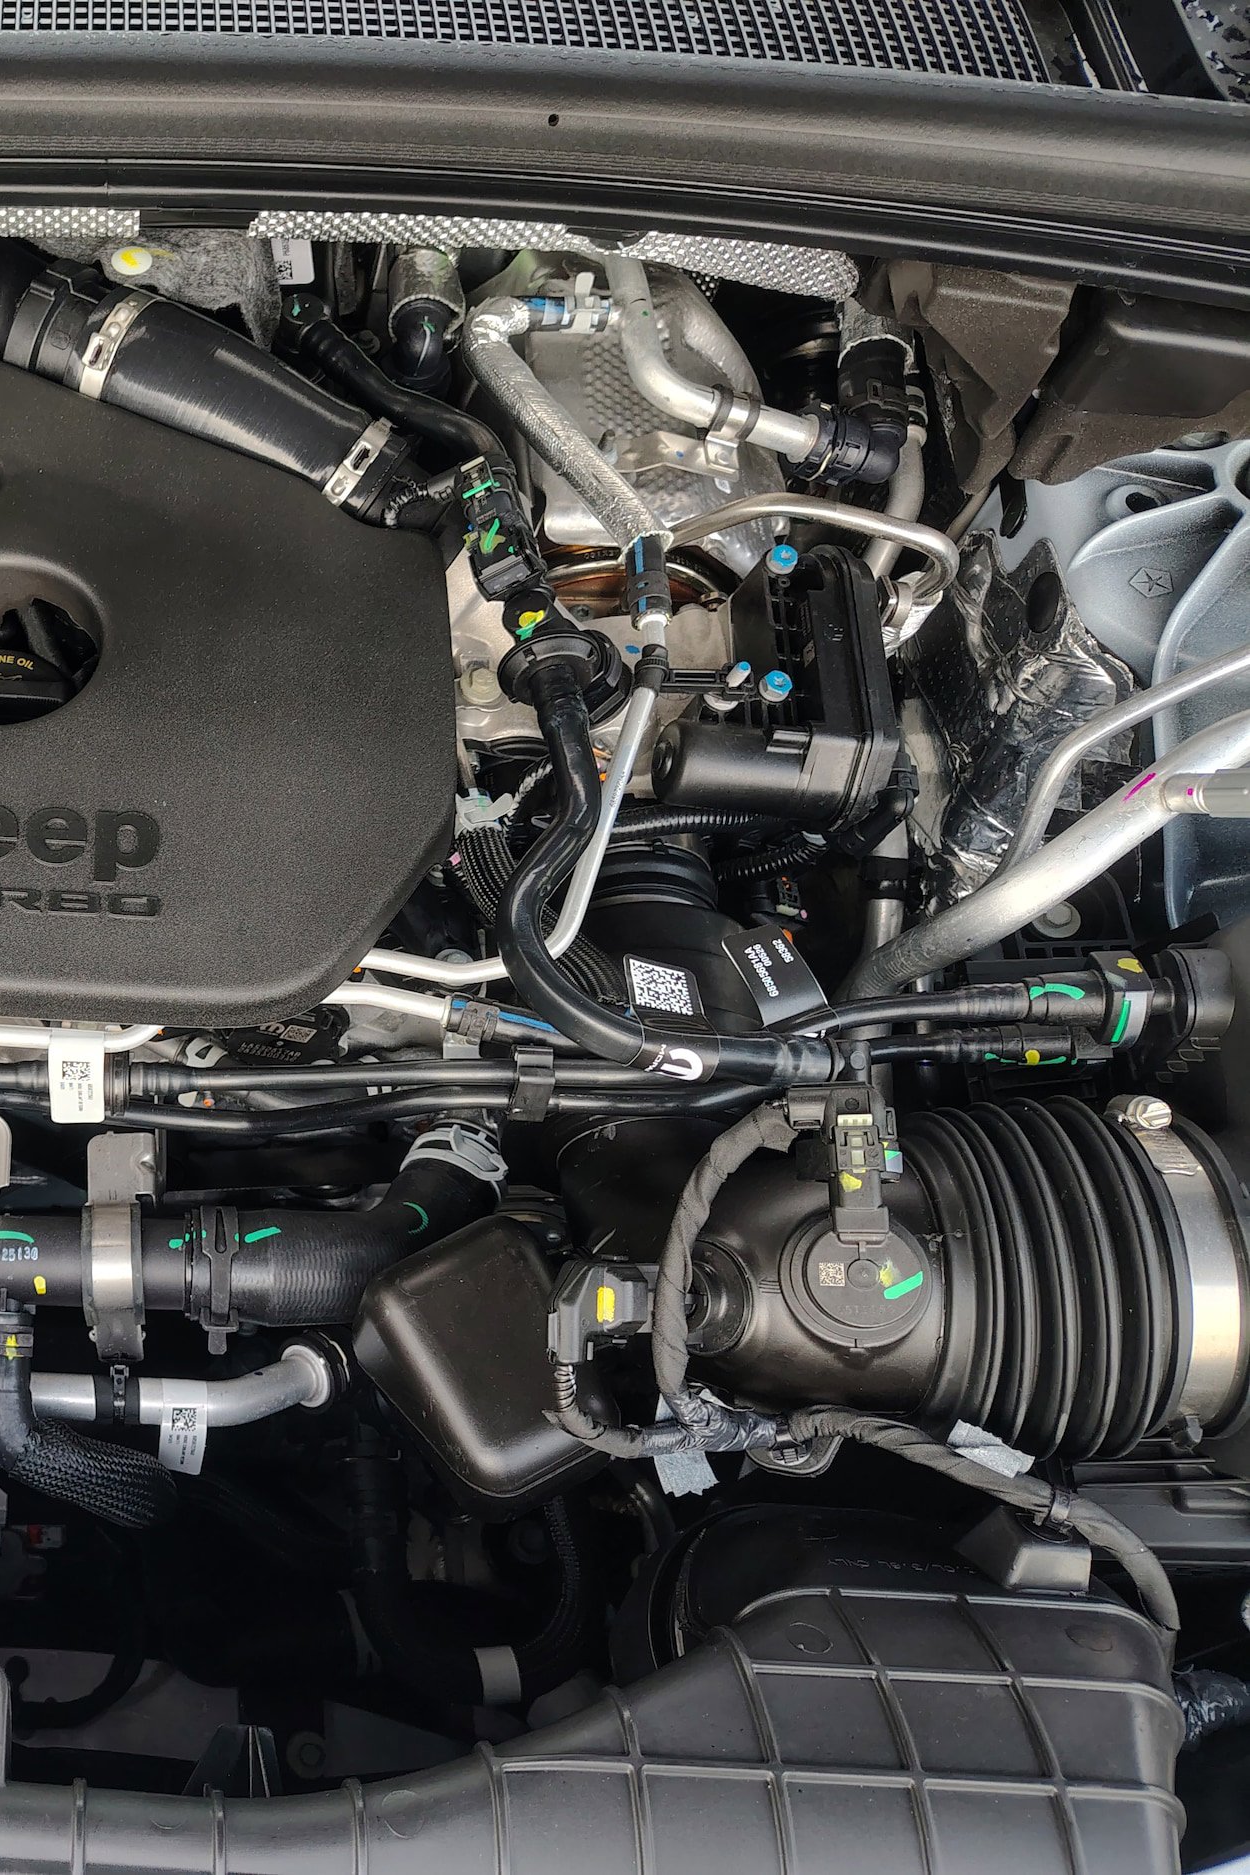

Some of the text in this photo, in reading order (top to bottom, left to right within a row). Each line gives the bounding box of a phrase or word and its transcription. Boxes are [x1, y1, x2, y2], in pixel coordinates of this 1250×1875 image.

[16, 657, 35, 670] OIL
[752, 943, 773, 967] 00526
[772, 938, 795, 964] 58362
[744, 946, 780, 998] 68505681AA
